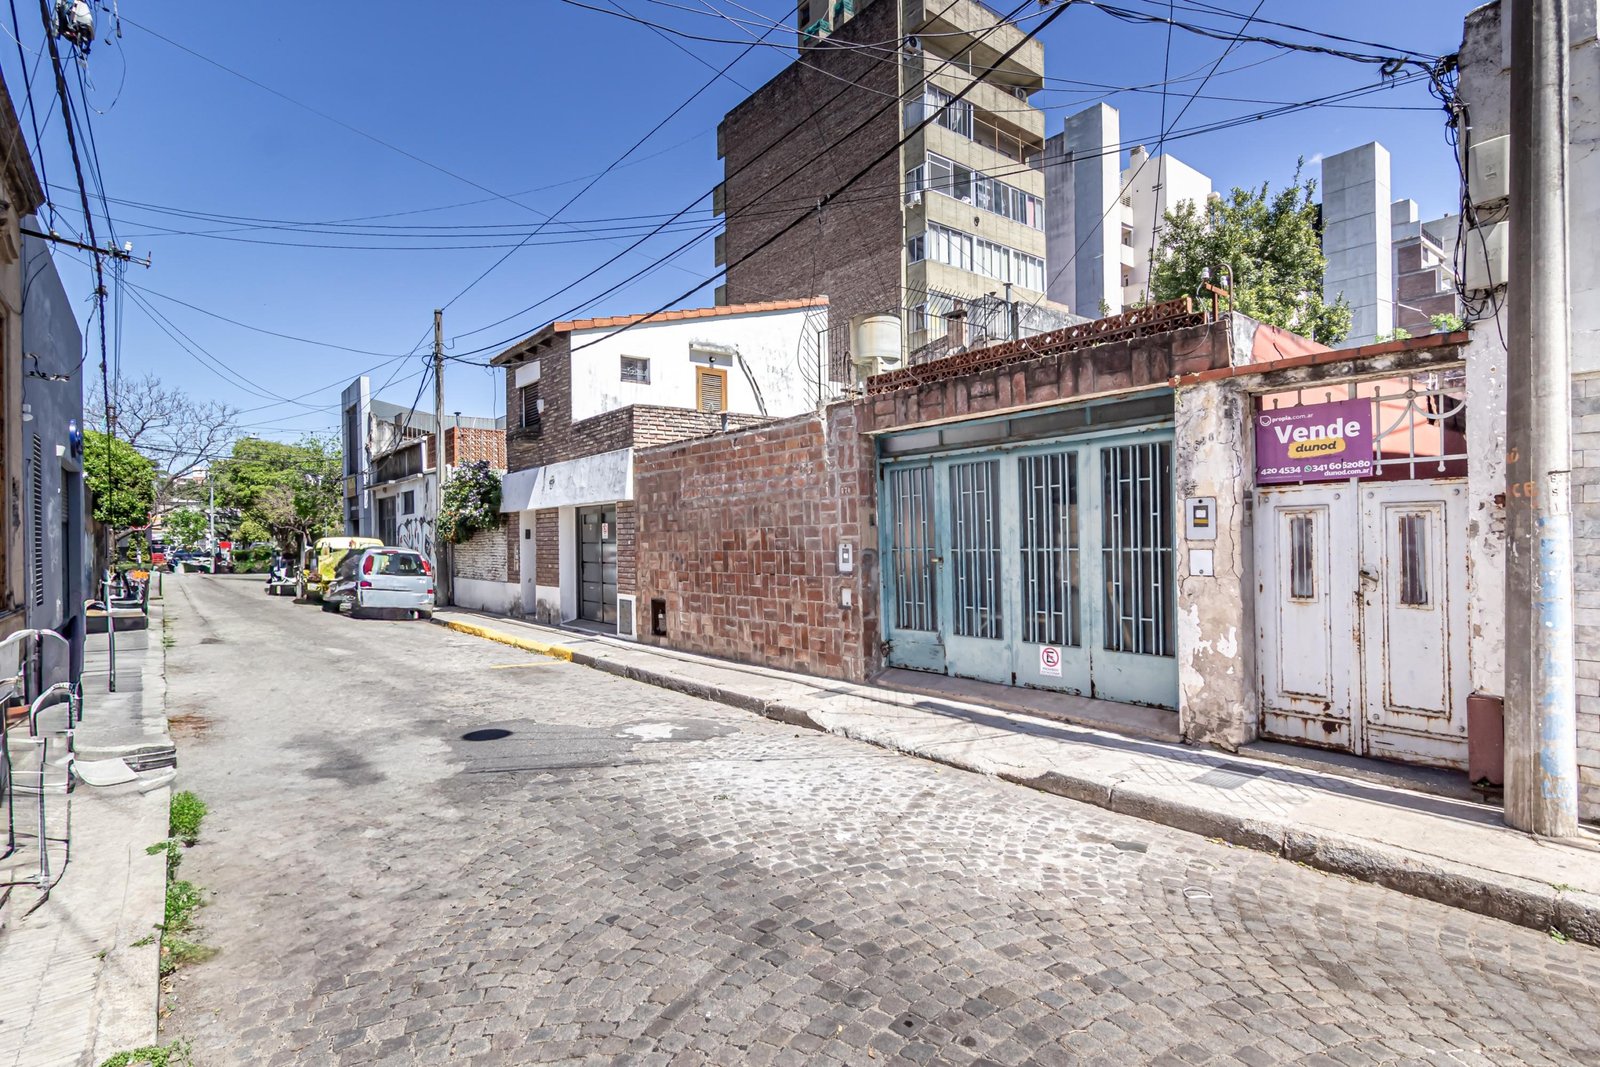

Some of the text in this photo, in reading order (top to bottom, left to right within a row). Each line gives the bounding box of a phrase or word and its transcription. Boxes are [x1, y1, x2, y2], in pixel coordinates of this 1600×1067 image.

[1274, 417, 1360, 444] Vende
[1295, 440, 1337, 453] dunod
[1278, 466, 1301, 474] 4534
[1312, 464, 1328, 472] 341
[1323, 468, 1370, 477] dunod.com.ar
